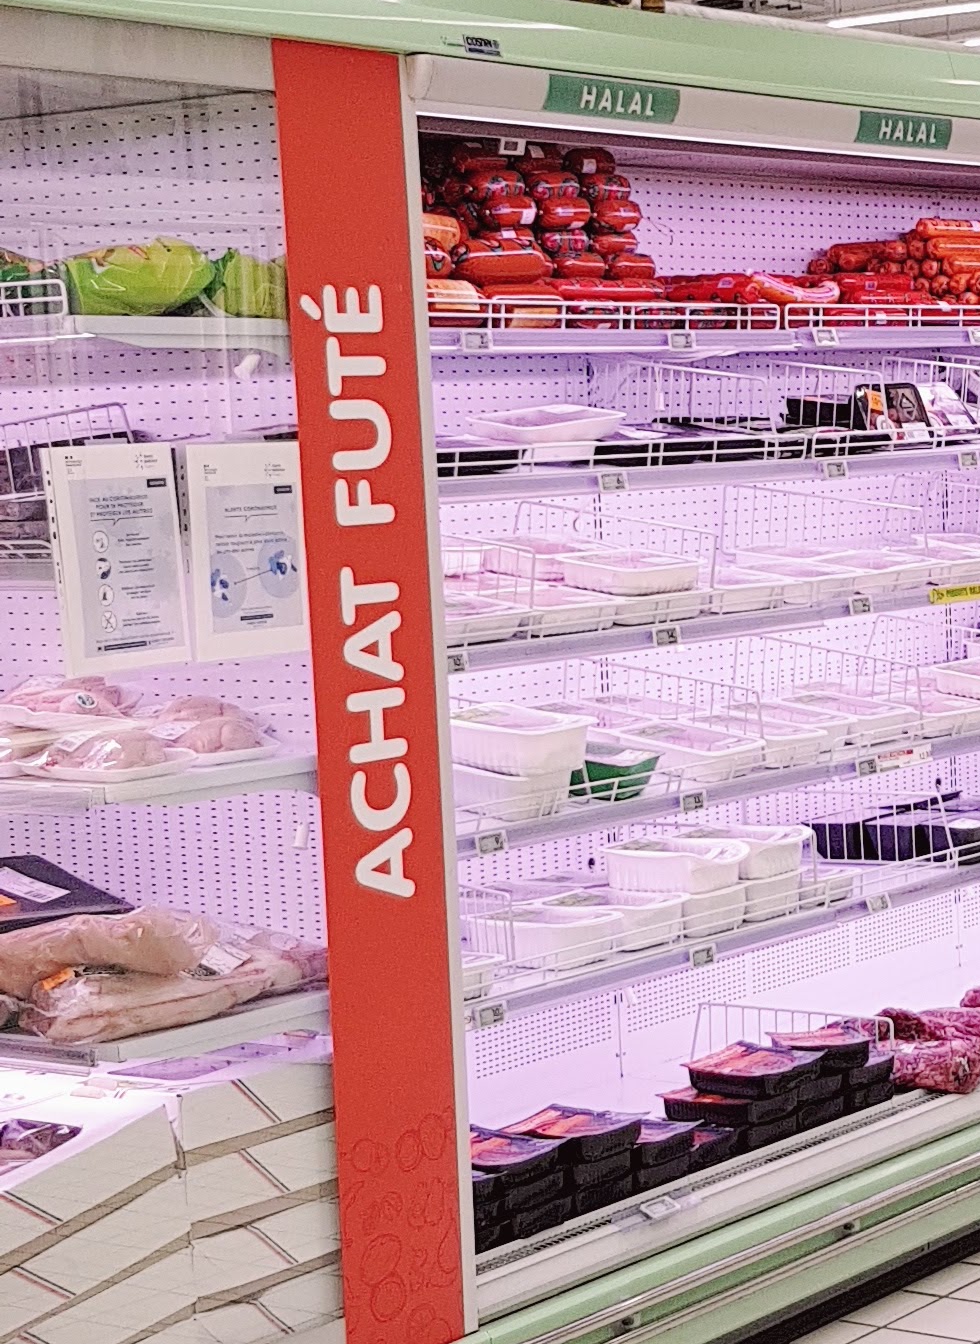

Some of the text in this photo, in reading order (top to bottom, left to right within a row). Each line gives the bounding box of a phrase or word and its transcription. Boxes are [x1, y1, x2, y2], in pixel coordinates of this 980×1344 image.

[579, 85, 655, 117] HALAL
[878, 119, 937, 144] HALAL
[300, 283, 416, 899] ACHAT FUTÉ
